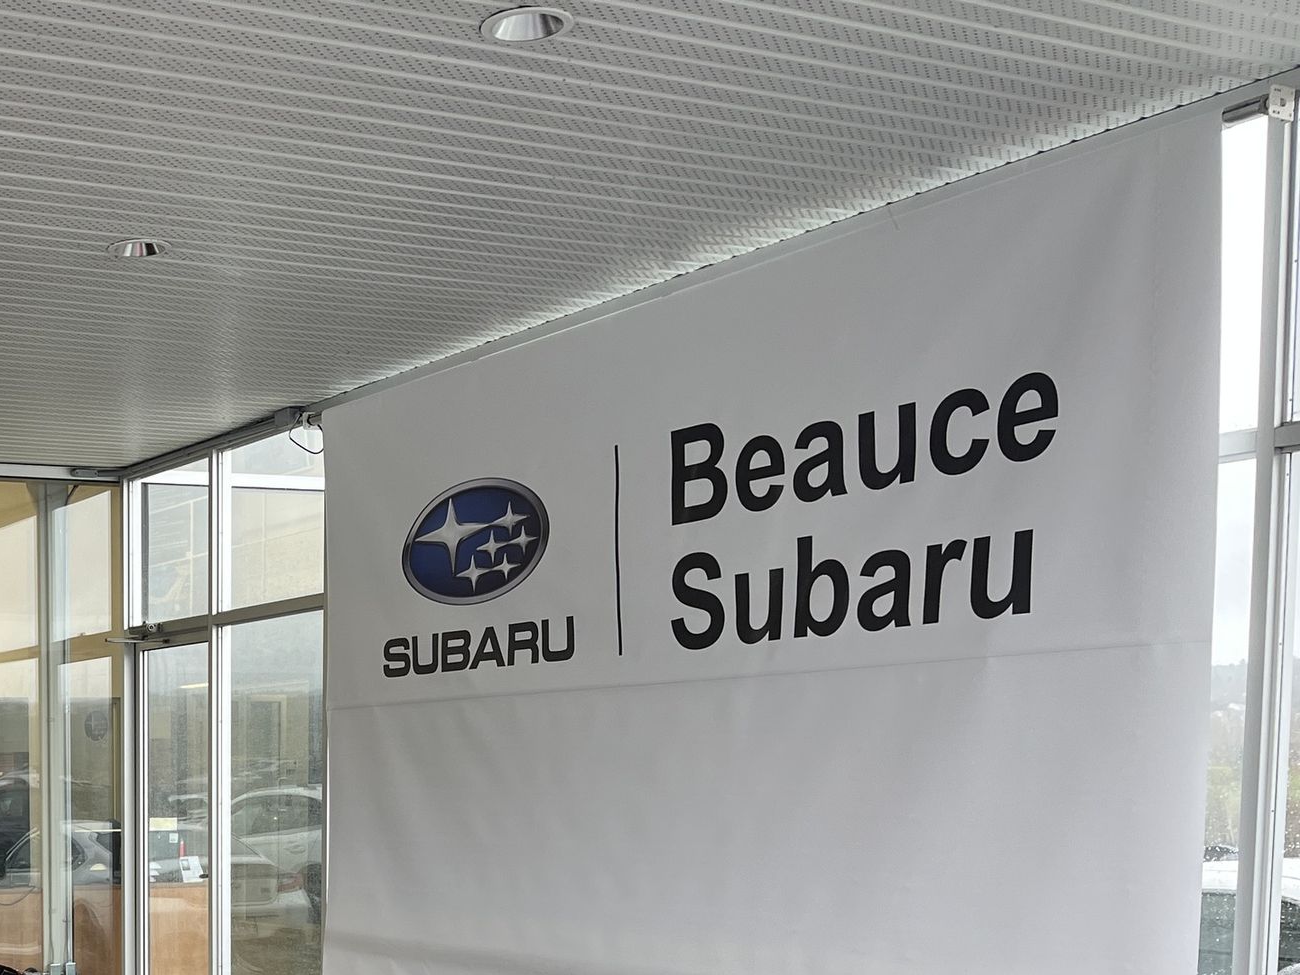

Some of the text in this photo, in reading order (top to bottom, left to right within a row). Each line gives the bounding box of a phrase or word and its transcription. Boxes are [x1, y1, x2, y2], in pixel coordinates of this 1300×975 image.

[670, 371, 1059, 526] Beauce
[382, 615, 575, 678] SUBARU
[670, 528, 1035, 651] Subaru
